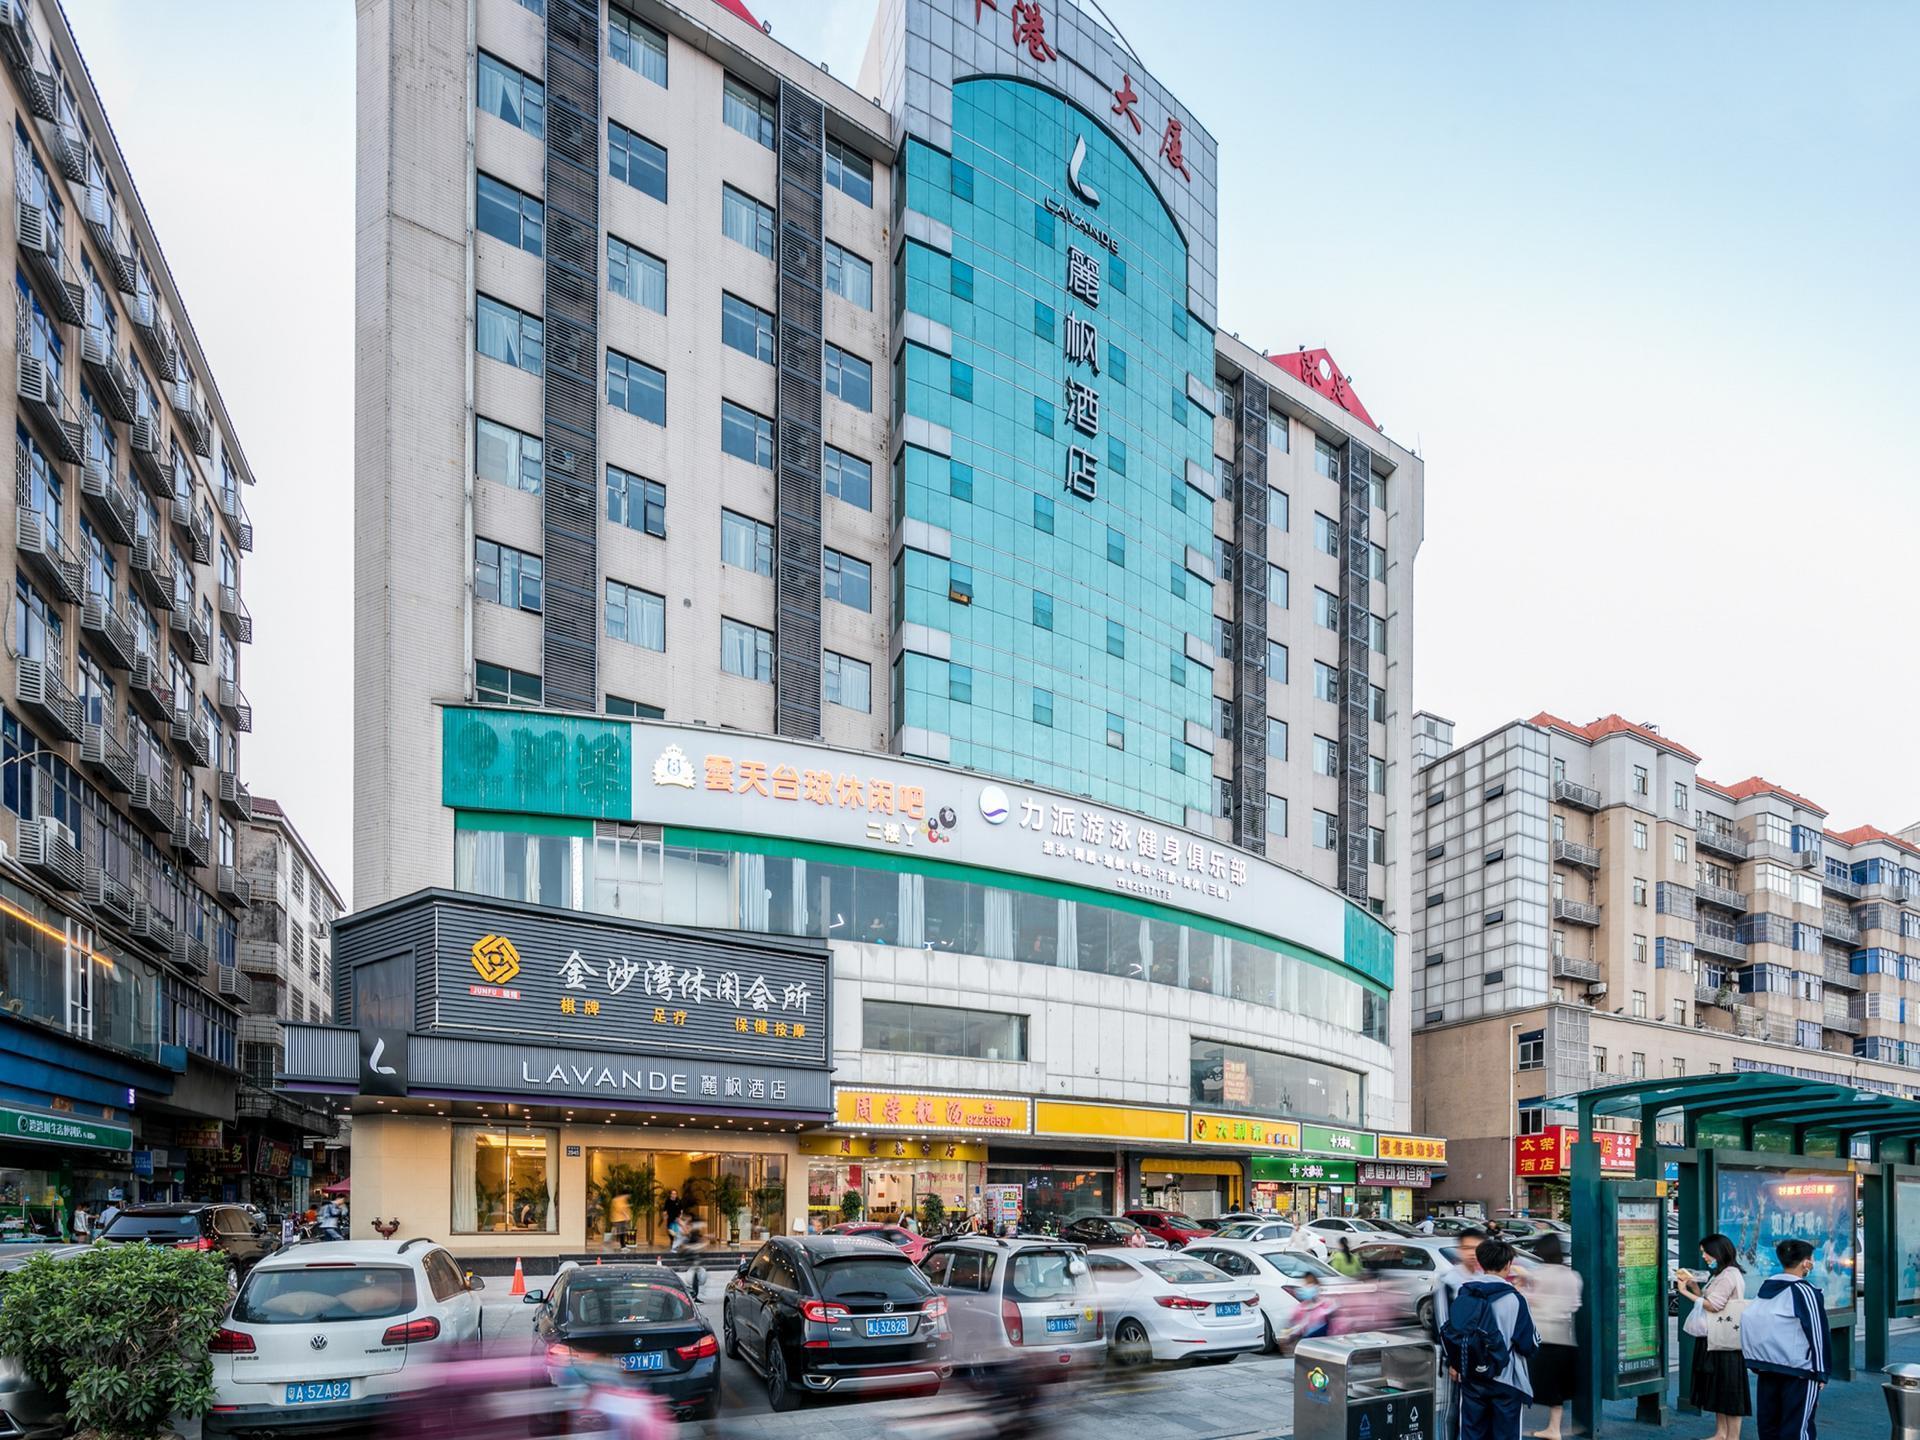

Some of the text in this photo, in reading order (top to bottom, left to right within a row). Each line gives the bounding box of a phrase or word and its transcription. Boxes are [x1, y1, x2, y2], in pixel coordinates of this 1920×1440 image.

[973, 0, 1191, 182] 港大厦
[1045, 195, 1119, 252] LAVANDE
[703, 754, 926, 820] 雲天台球休闲吧
[1018, 797, 1247, 886] 力派游泳健身俱乐部
[557, 949, 812, 1018] 金沙湾休闲会所
[560, 997, 806, 1039] 棋牌 足疗 保健按摩
[522, 1061, 786, 1101] LAVANDE 麗枫酒店
[1520, 1137, 1555, 1151] 太荣
[1520, 1157, 1555, 1172] 酒店
[1364, 1163, 1426, 1182] 德信动物诊所
